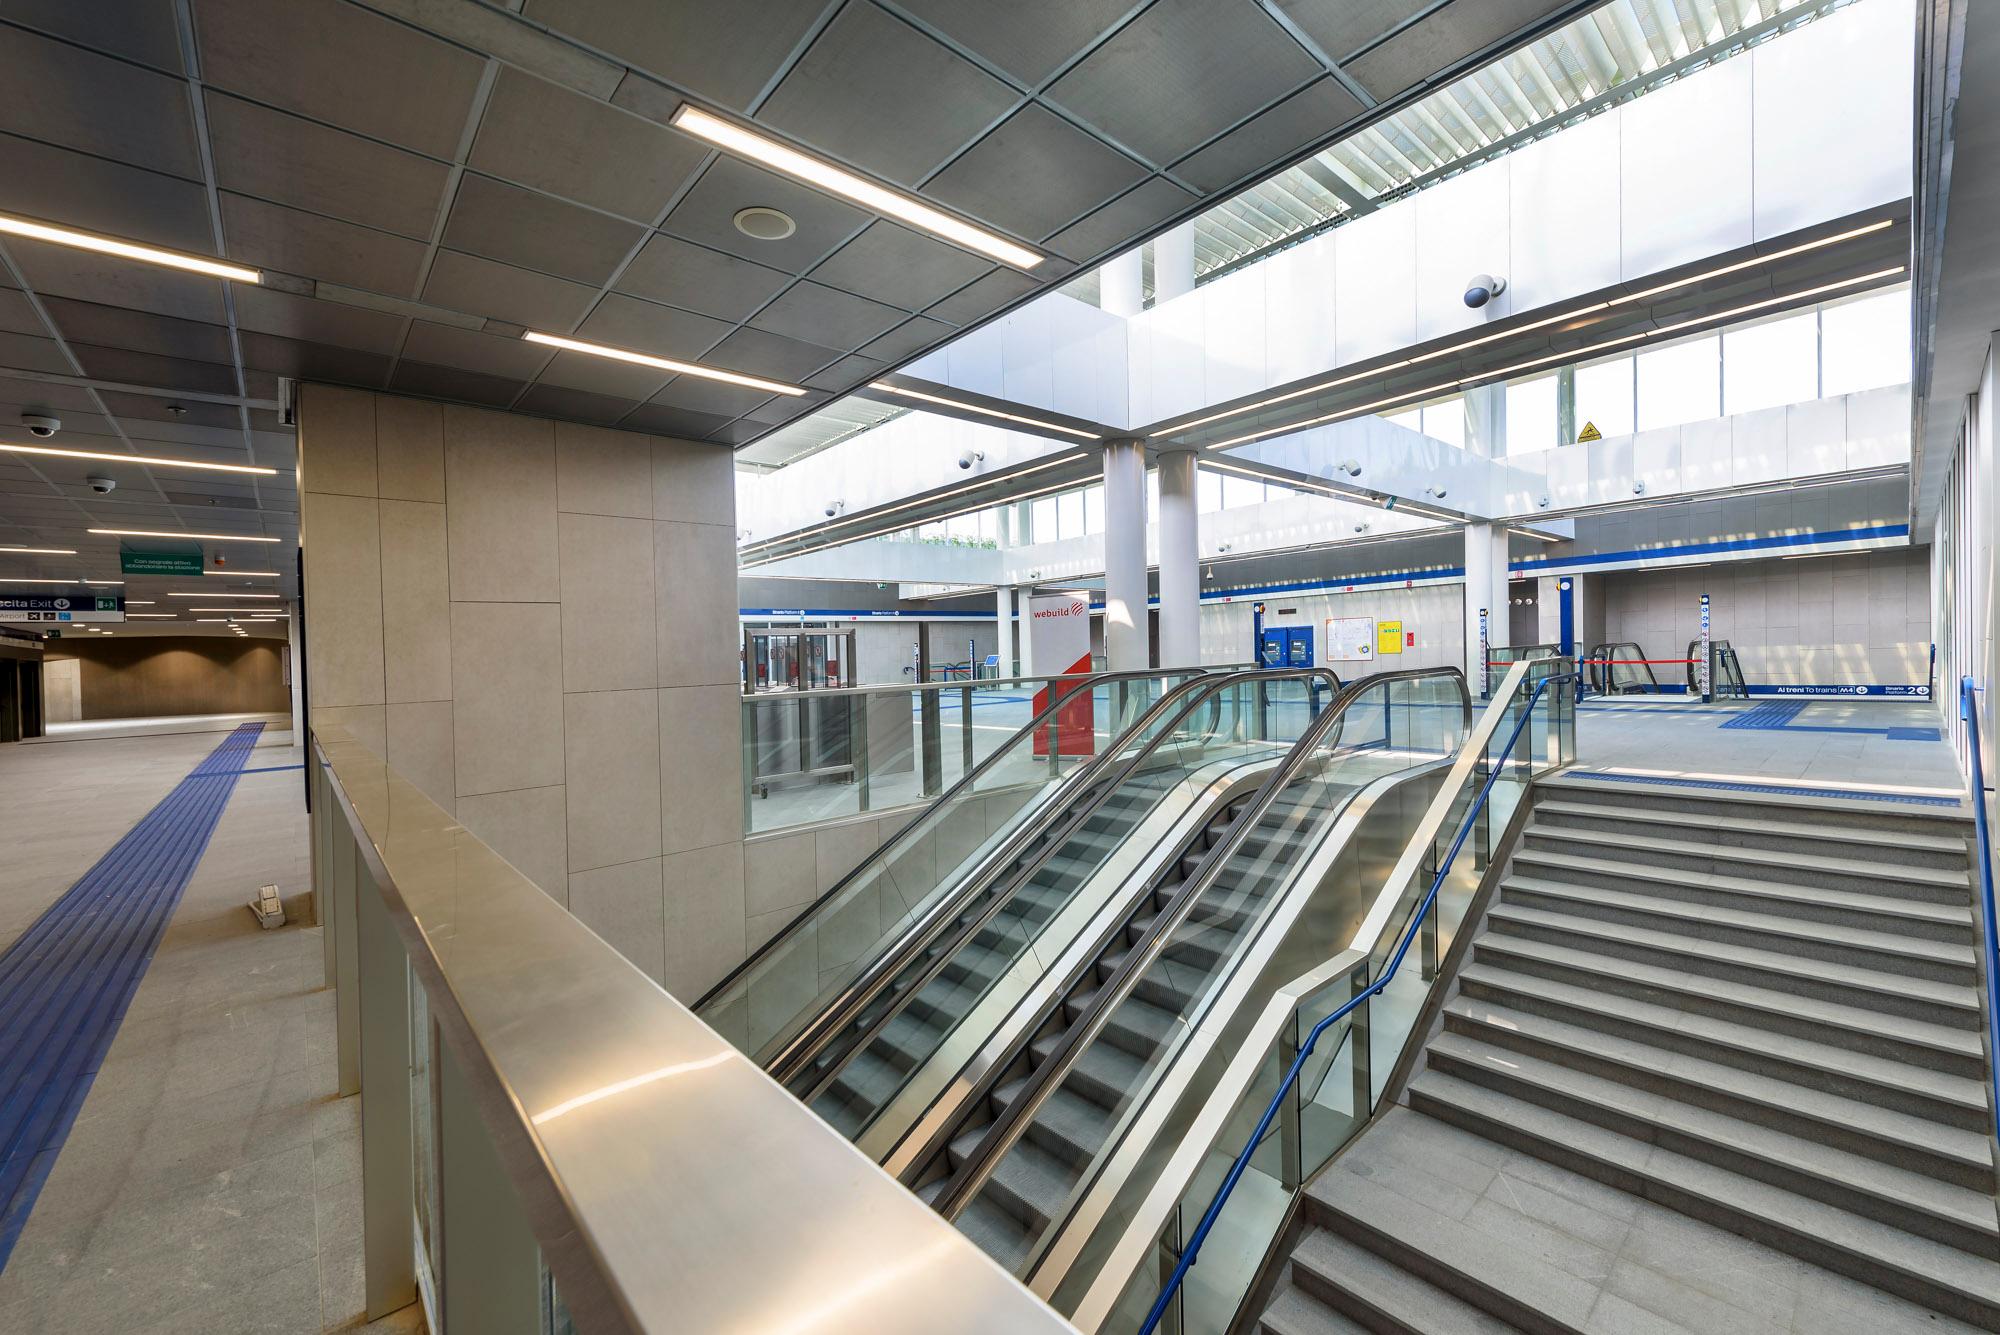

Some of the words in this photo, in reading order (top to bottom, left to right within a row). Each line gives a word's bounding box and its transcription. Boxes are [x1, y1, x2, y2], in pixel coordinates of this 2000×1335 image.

[30, 599, 53, 608] Exit
[1034, 608, 1069, 619] webuild
[1907, 686, 1916, 695] 2
